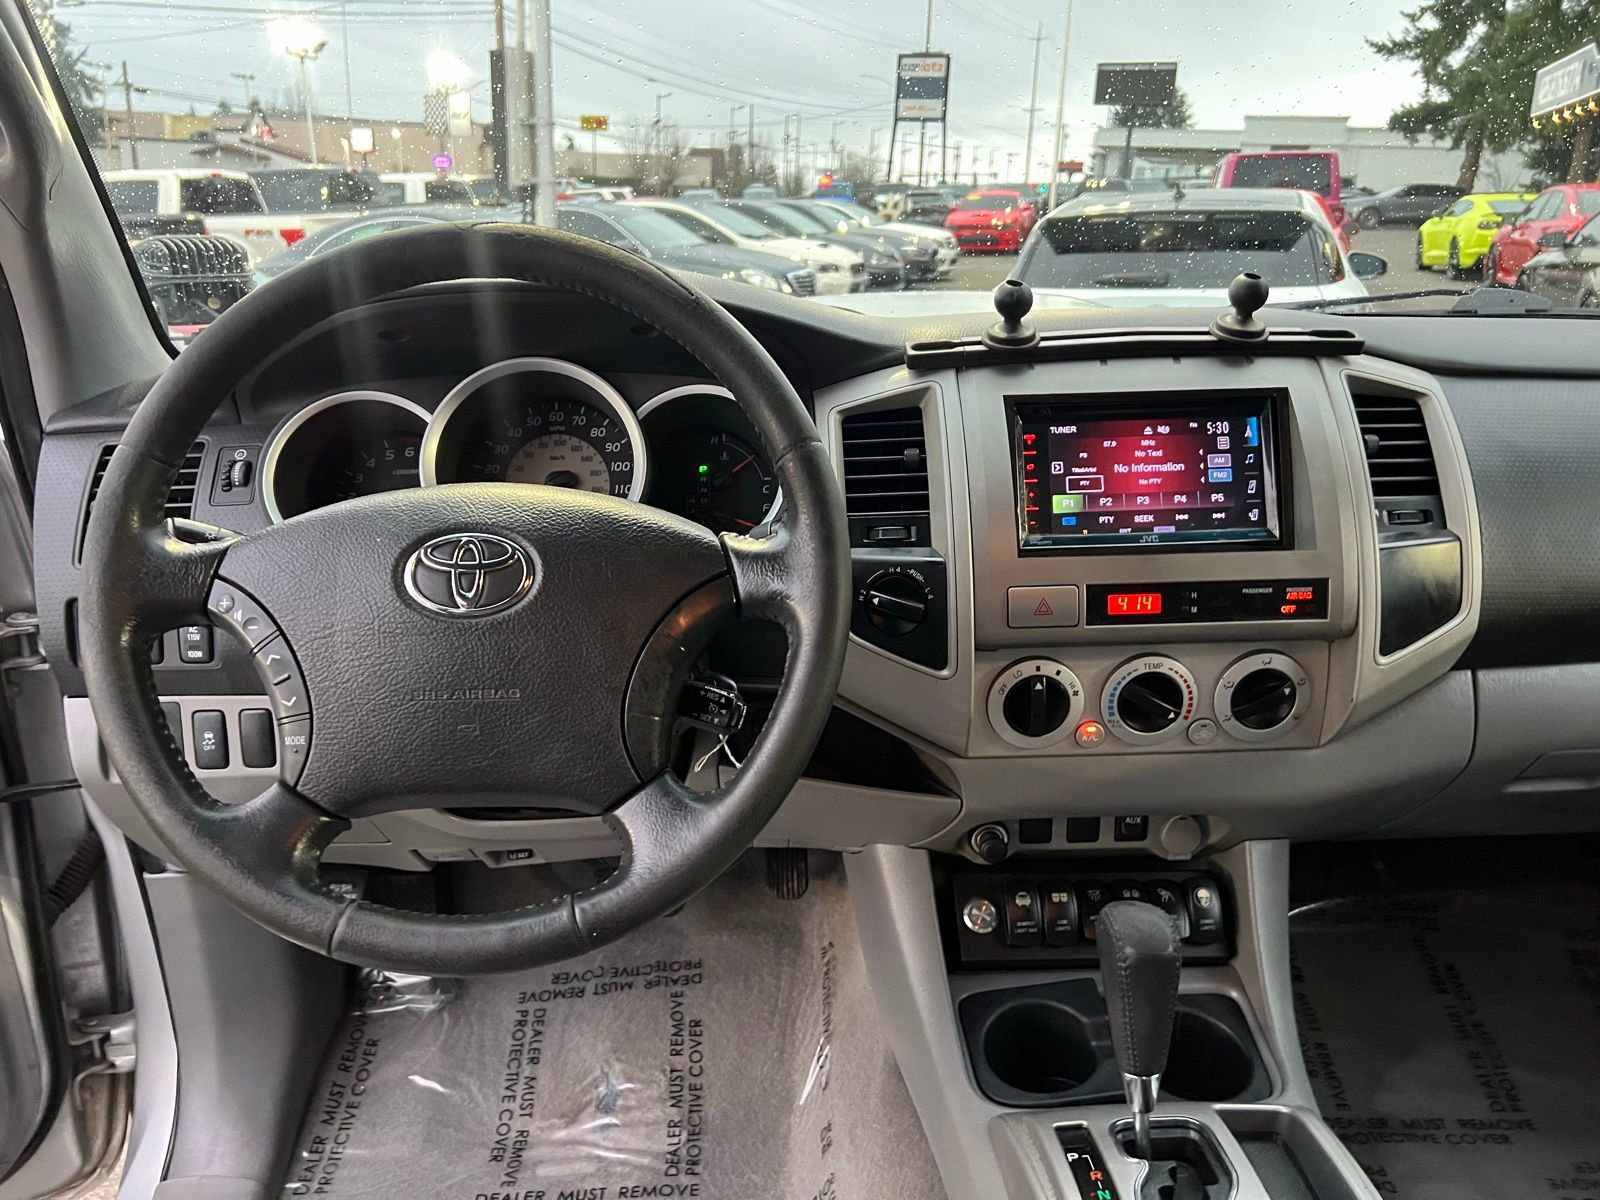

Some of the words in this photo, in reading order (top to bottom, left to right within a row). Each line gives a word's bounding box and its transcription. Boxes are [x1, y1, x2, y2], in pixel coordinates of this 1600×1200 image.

[549, 411, 565, 421] 60
[572, 415, 587, 426] 70
[590, 427, 606, 437] 80
[1050, 426, 1077, 434] TUNER
[1207, 421, 1229, 434] 5:30
[404, 447, 415, 457] 6
[605, 442, 621, 453] 90
[1148, 449, 1163, 457] Text
[384, 450, 395, 460] 5
[610, 461, 631, 472] 100
[699, 465, 708, 473] P
[1114, 464, 1129, 473] No
[1131, 462, 1186, 473] Information
[763, 485, 771, 494] C
[1062, 500, 1074, 508] P1
[1099, 497, 1113, 506] P2
[1136, 496, 1150, 505] P3
[1174, 494, 1187, 503] P4
[1211, 493, 1225, 502] P5
[763, 503, 771, 512] F
[1098, 516, 1114, 524] PTY
[1134, 514, 1154, 523] SEEK
[1139, 535, 1159, 543] JVC
[1191, 591, 1198, 599] H
[1191, 605, 1198, 613] M
[1280, 605, 1297, 613] OFF
[188, 626, 199, 634] AC
[1143, 662, 1164, 670] TEMP
[1012, 670, 1023, 680] LO
[453, 689, 520, 699] AIRBAG
[997, 682, 1008, 696] OFF
[706, 691, 720, 700] RES
[285, 735, 306, 744] MODE
[1125, 816, 1142, 824] AUX
[611, 957, 702, 978] PROTECTIVE
[551, 965, 605, 985] COVER
[644, 973, 702, 990] DEALER
[592, 981, 634, 996] MUST
[517, 985, 586, 1004] REMOVE
[669, 990, 685, 1057] REMOVE
[526, 1007, 547, 1066] DEALER
[688, 1018, 704, 1078] COVER
[501, 1009, 529, 1104] PROTECTIVE
[669, 1067, 684, 1109] MUST
[518, 1076, 537, 1119] MUST
[313, 1100, 361, 1194] PROTECTIVE
[351, 1038, 380, 1097] COVER
[685, 1082, 704, 1176] PROTECTIVE
[1401, 1118, 1446, 1130] MUST
[1457, 1118, 1537, 1131] REMOVE
[292, 1135, 329, 1195] DEALER
[320, 1081, 347, 1126] MUST
[488, 1108, 514, 1164] COVER
[1444, 1133, 1512, 1145] COVER
[664, 1119, 683, 1177] DEALER
[500, 1129, 530, 1188] REMOVE
[1067, 1152, 1079, 1163] P
[1089, 1170, 1103, 1181] R
[619, 1183, 701, 1199] REMOVE
[1096, 1189, 1111, 1200] N
